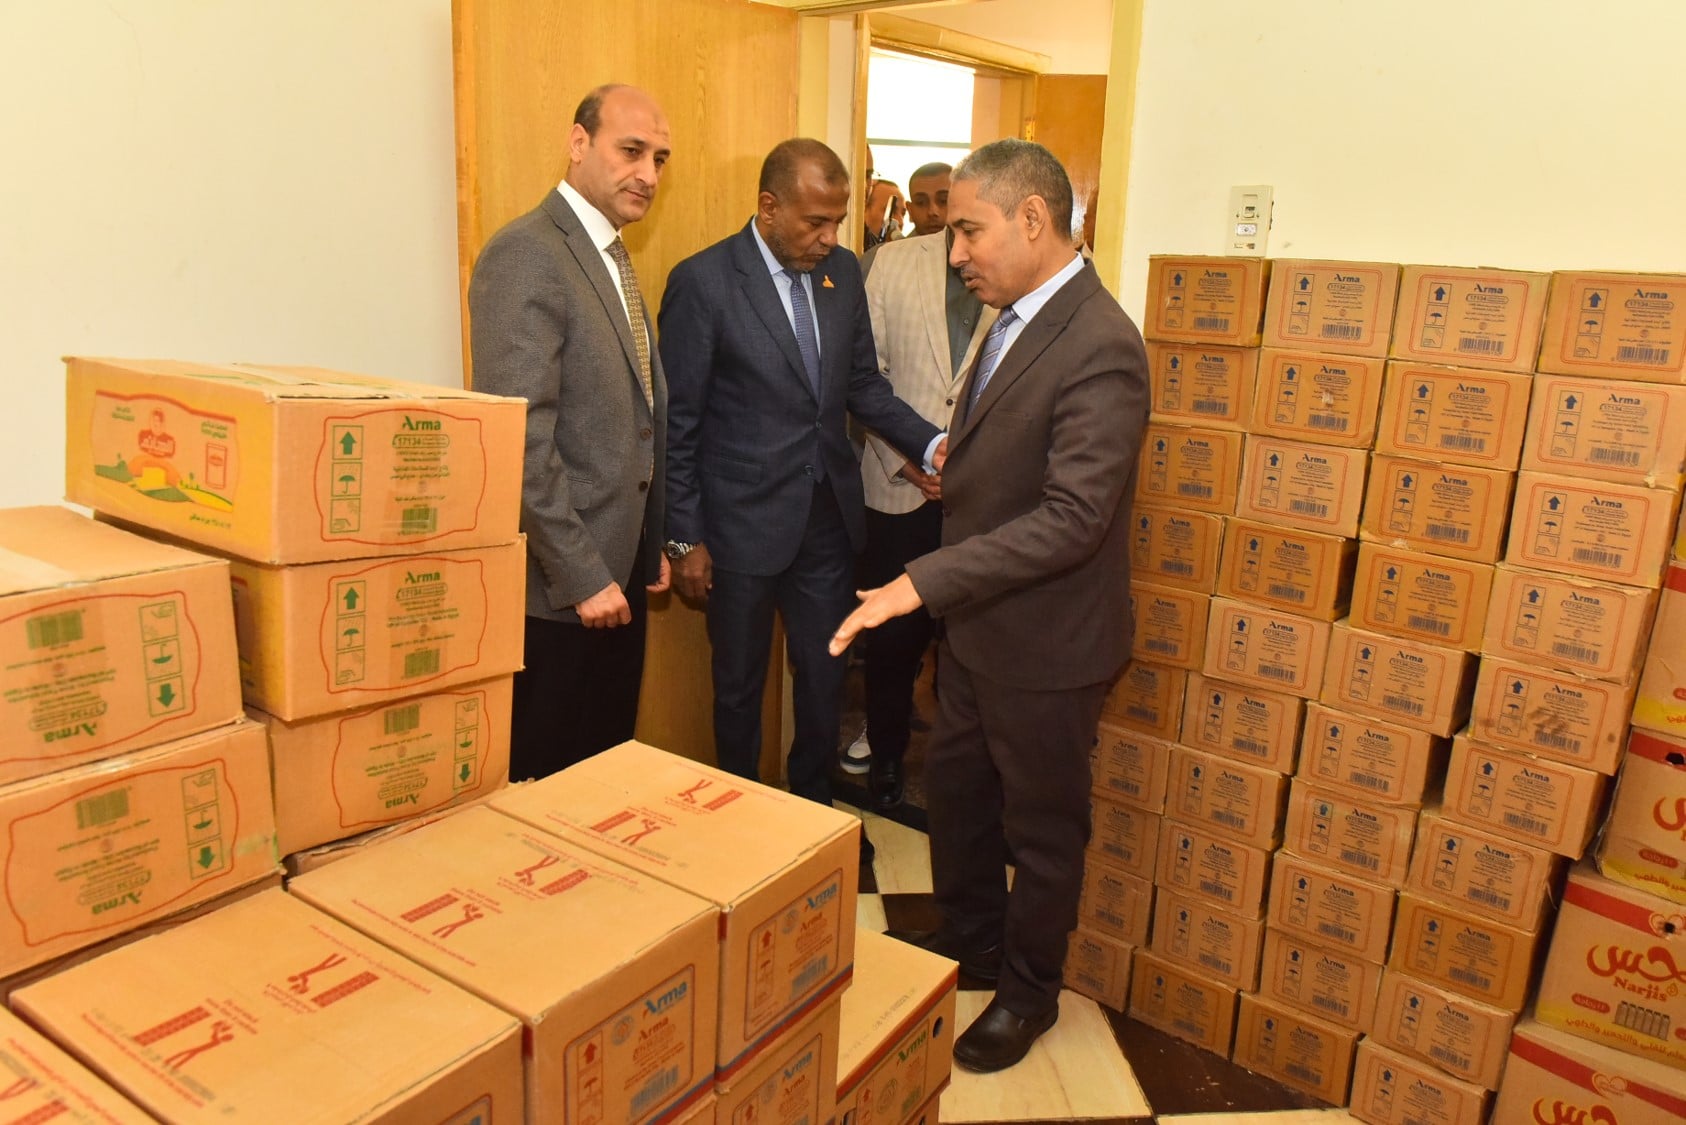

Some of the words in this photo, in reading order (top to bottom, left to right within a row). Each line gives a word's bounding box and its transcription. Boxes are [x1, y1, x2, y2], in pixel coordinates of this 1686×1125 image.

[1204, 269, 1227, 278] Arma
[1334, 274, 1360, 283] Arma
[1474, 284, 1503, 294] Arma
[1634, 289, 1667, 300] Arma
[1201, 354, 1224, 363] Arma
[1320, 366, 1346, 375] Arma
[1457, 383, 1485, 394] Arma
[1609, 394, 1640, 405] Arma
[402, 416, 441, 431] Arma
[398, 437, 421, 445] 17134
[1186, 439, 1209, 448] Arma
[1302, 454, 1327, 464] Arma
[1440, 475, 1468, 486] Arma
[1591, 497, 1622, 508] Arma
[1169, 517, 1190, 527] Arma
[1281, 540, 1305, 550] Arma
[404, 572, 440, 584] Arma
[1423, 569, 1450, 580] Arma
[1154, 598, 1177, 608] Arma
[1570, 592, 1599, 604] Arma
[1269, 621, 1293, 632] Arma
[1397, 651, 1423, 663] Arma
[1552, 685, 1582, 698] Arma
[1243, 697, 1265, 708] Arma
[44, 723, 97, 743] Arma
[1364, 729, 1389, 742] Arma
[1221, 771, 1244, 782] Arma
[1520, 768, 1549, 782] Arma
[386, 794, 419, 808] Arma
[1352, 808, 1377, 821] Arma
[1209, 843, 1231, 855] Arma
[1483, 845, 1510, 858] Arma
[1330, 884, 1354, 896] Arma
[92, 891, 143, 914] Arma
[805, 882, 838, 912] Arma
[1464, 927, 1490, 941] Arma
[1322, 956, 1345, 970] Arma
[1613, 976, 1667, 1002] Narjis
[643, 982, 687, 1019] Arma
[1444, 1006, 1469, 1021] Arma
[639, 1017, 669, 1042] Arma
[897, 1031, 927, 1065] Arma
[782, 1052, 812, 1084] Arma
[1416, 1080, 1441, 1095] Arma
